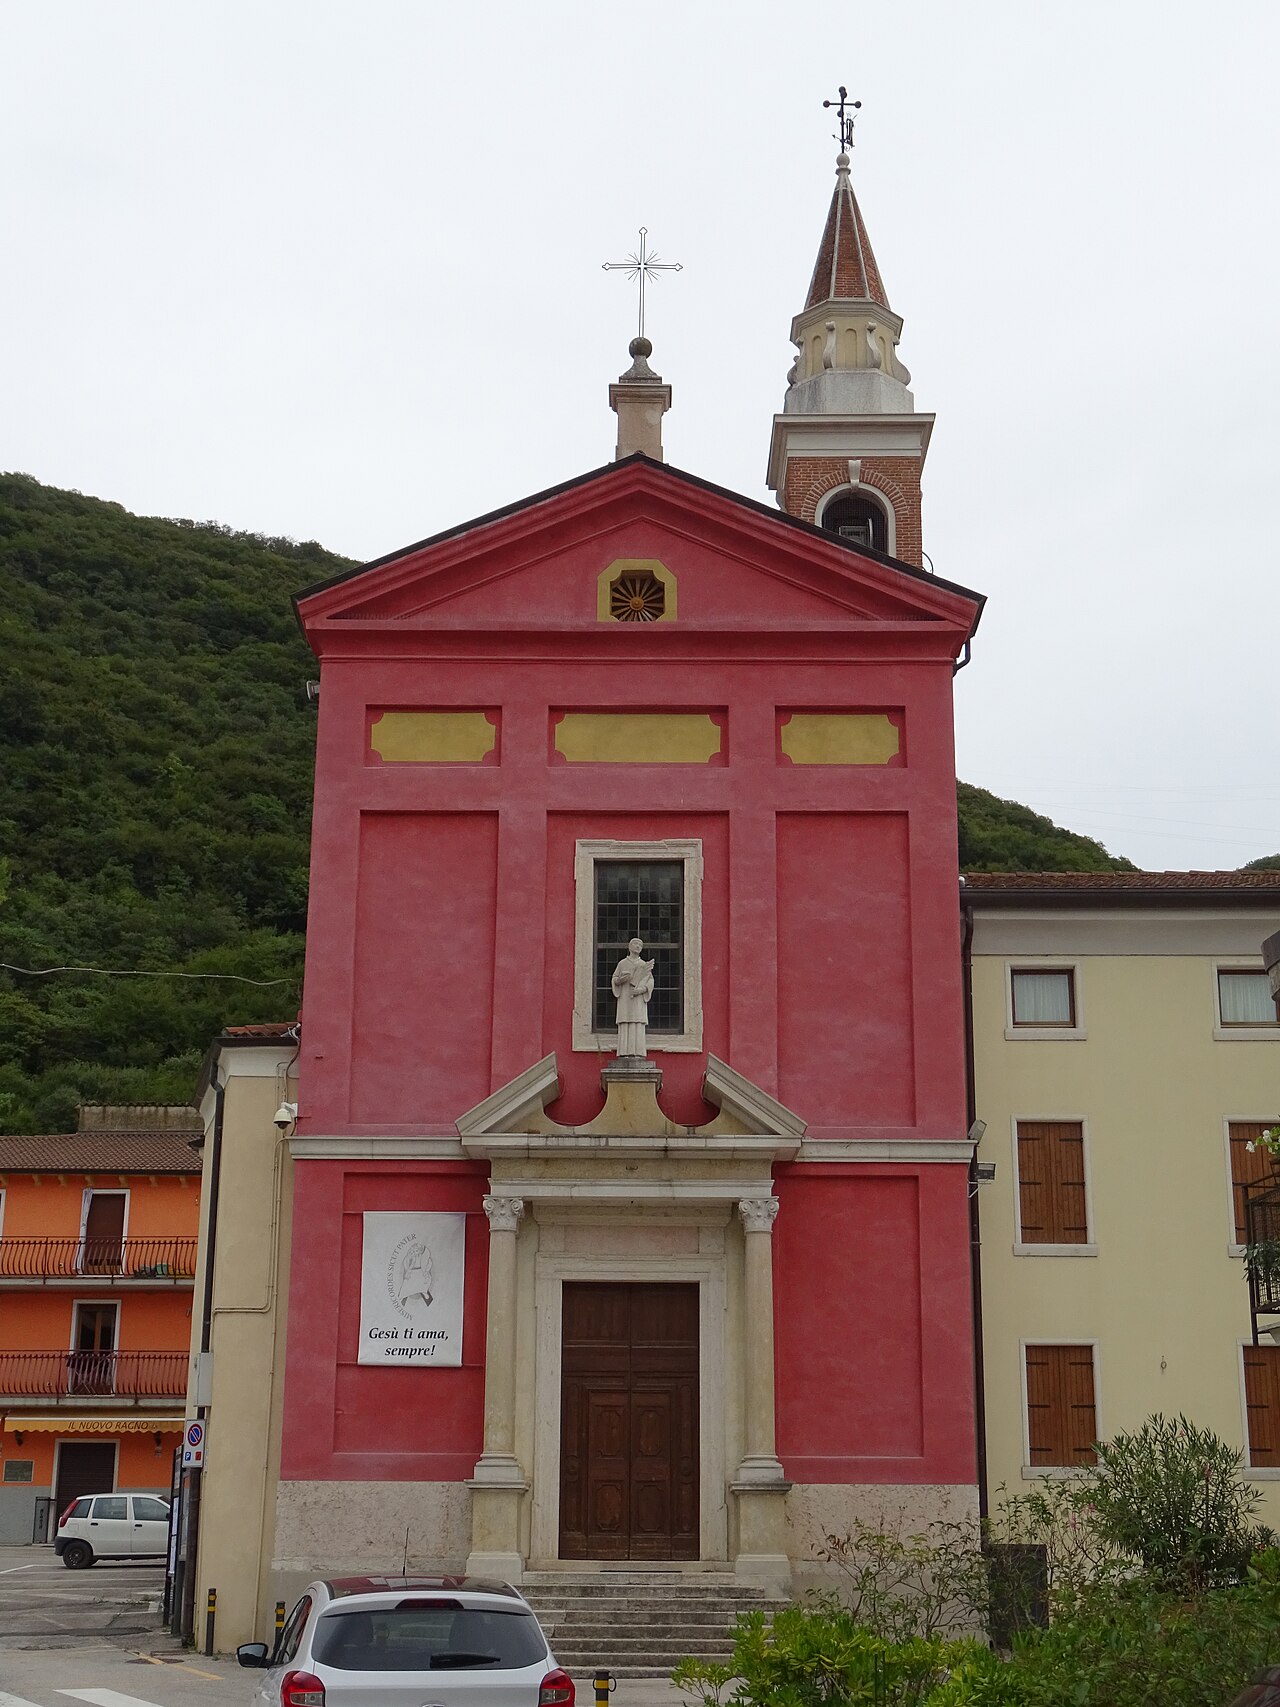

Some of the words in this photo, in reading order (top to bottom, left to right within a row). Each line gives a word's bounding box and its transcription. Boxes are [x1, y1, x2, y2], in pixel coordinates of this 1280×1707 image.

[388, 1250, 399, 1271] SICUT
[397, 1233, 417, 1251] PATER
[368, 1327, 399, 1340] Gesù
[403, 1327, 414, 1340] ti
[417, 1330, 449, 1341] ama,
[384, 1344, 436, 1359] sempre!
[68, 1421, 76, 1430] IL
[78, 1421, 113, 1430] NUOVO
[115, 1421, 149, 1430] RAGNO
